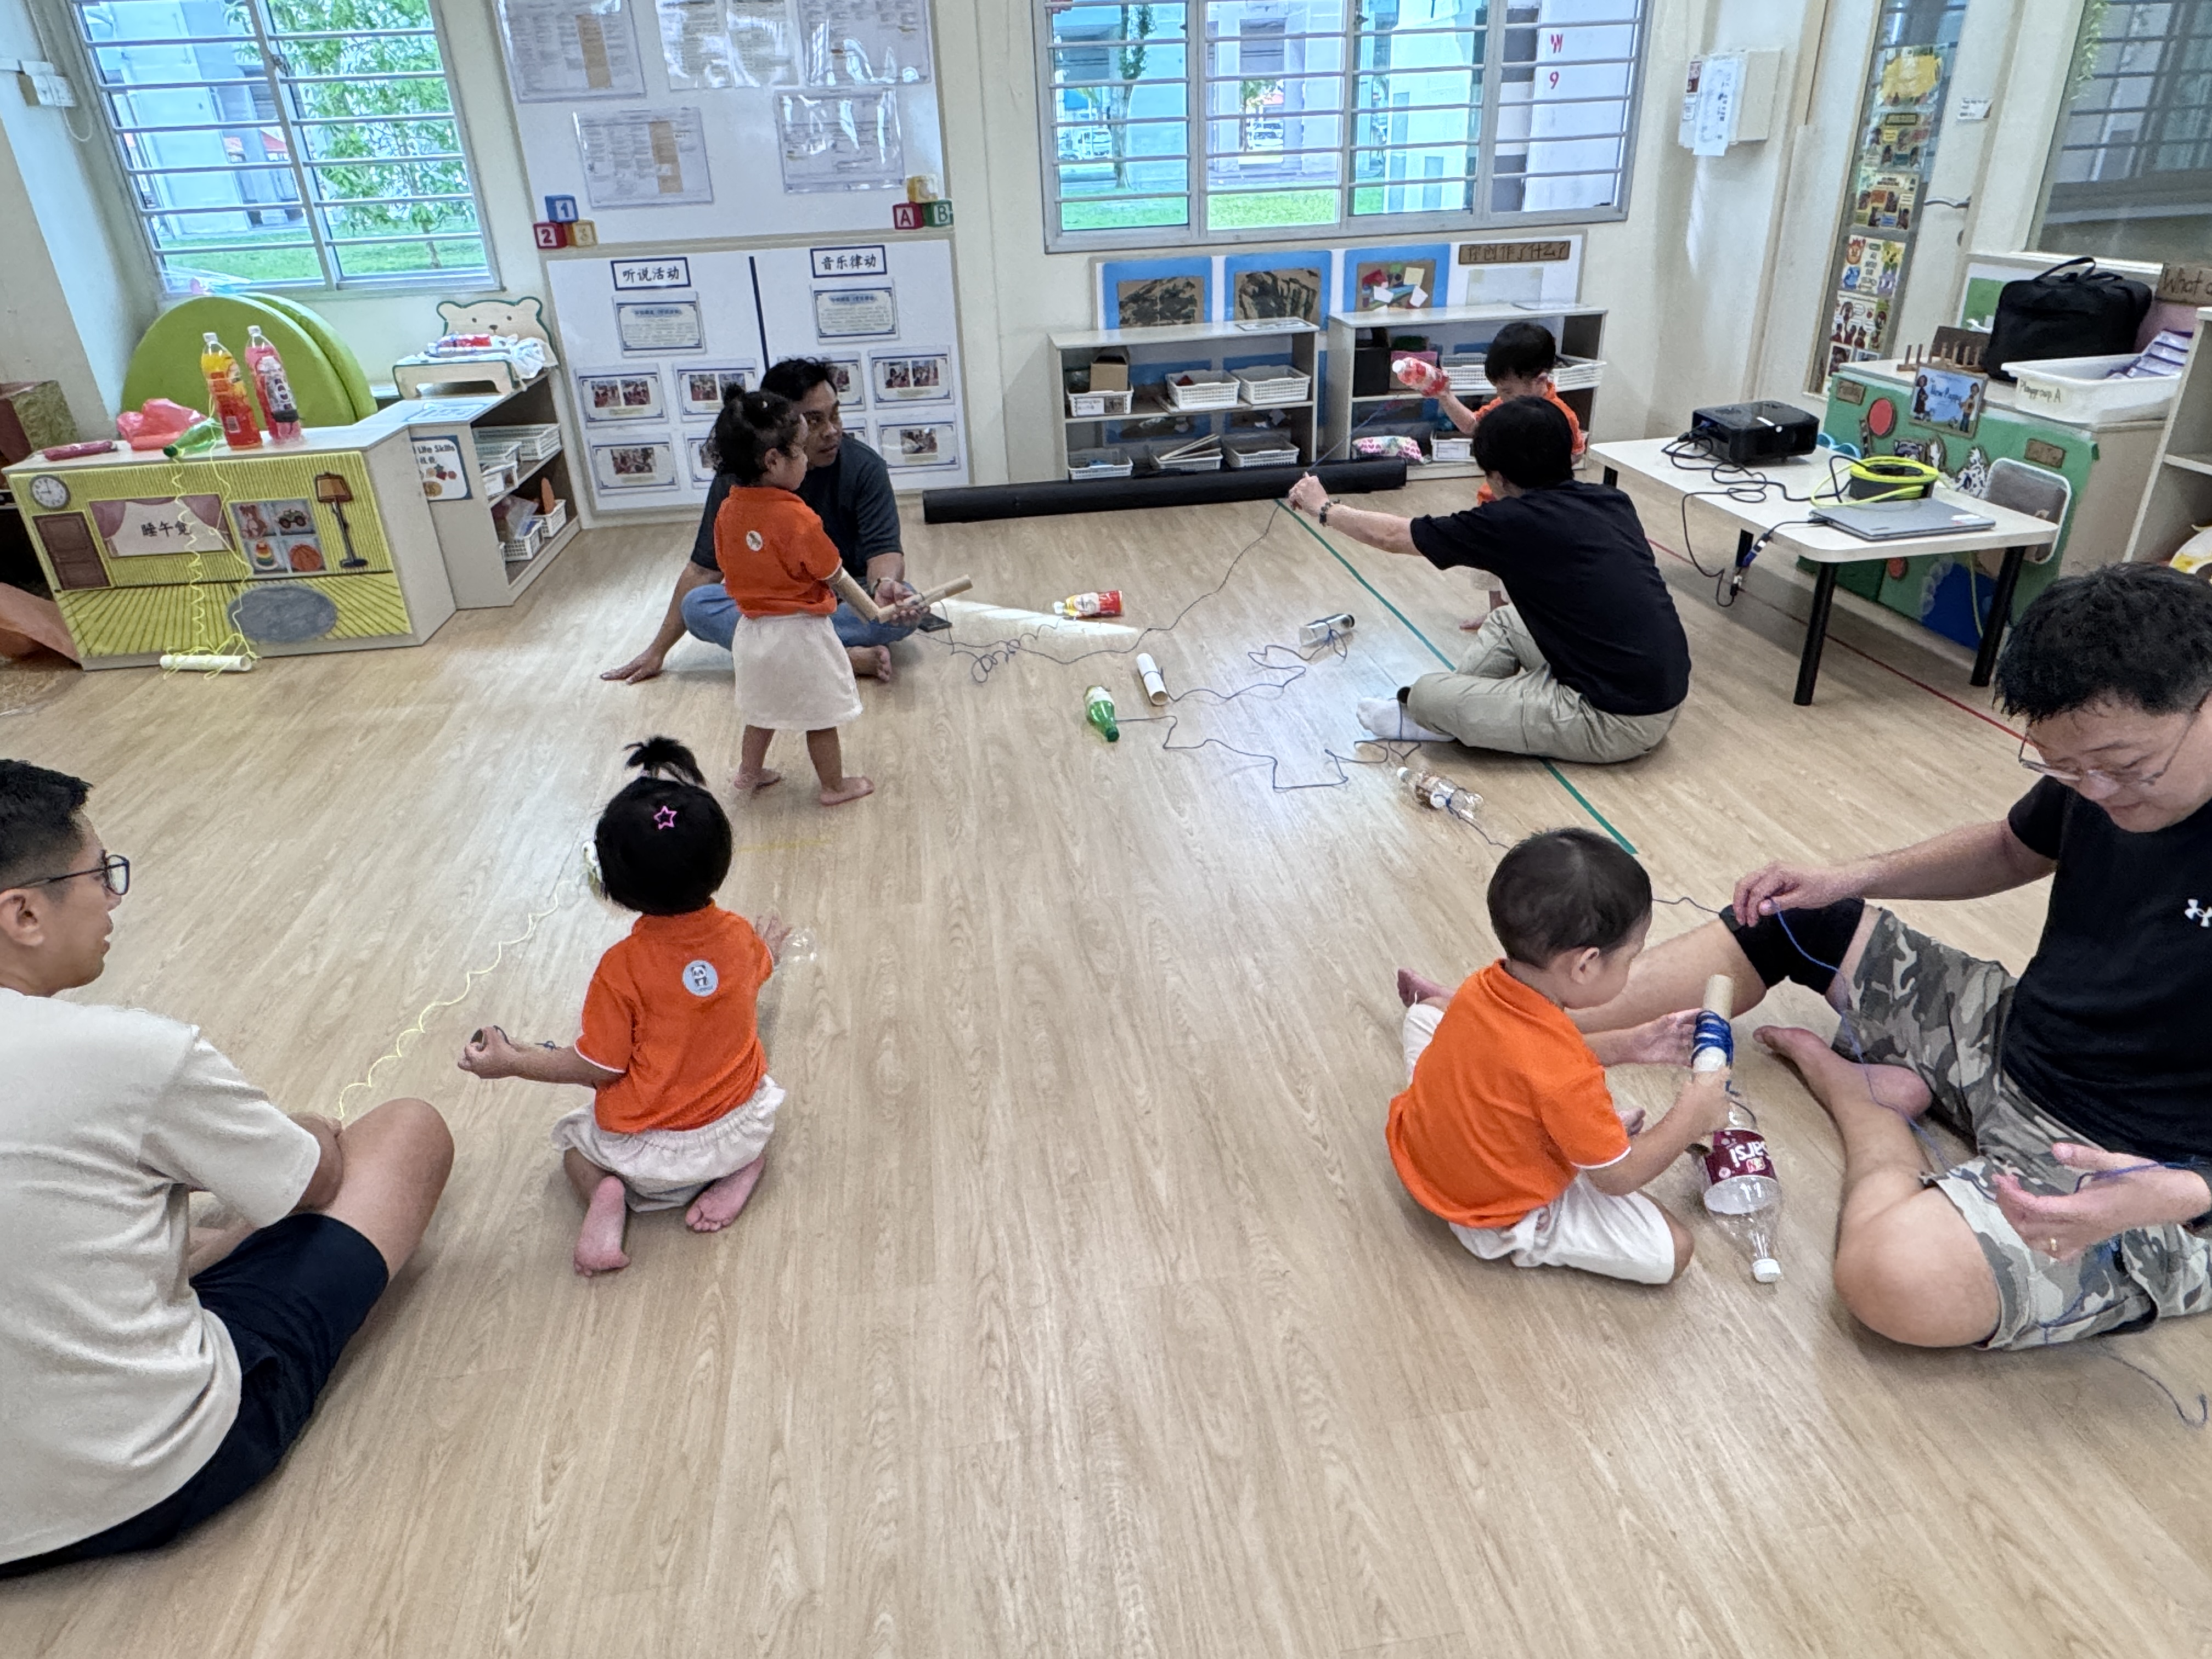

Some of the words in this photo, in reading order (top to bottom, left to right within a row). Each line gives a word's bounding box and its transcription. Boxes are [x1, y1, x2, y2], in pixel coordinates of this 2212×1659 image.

[1550, 34, 1564, 53] W
[1549, 71, 1559, 89] 9
[561, 202, 569, 218] 1
[901, 208, 912, 225] A
[937, 205, 948, 222] B
[541, 228, 553, 244] 2
[821, 253, 877, 270] 音乐律动
[622, 266, 679, 283] 听说活动
[2163, 267, 2203, 295] What
